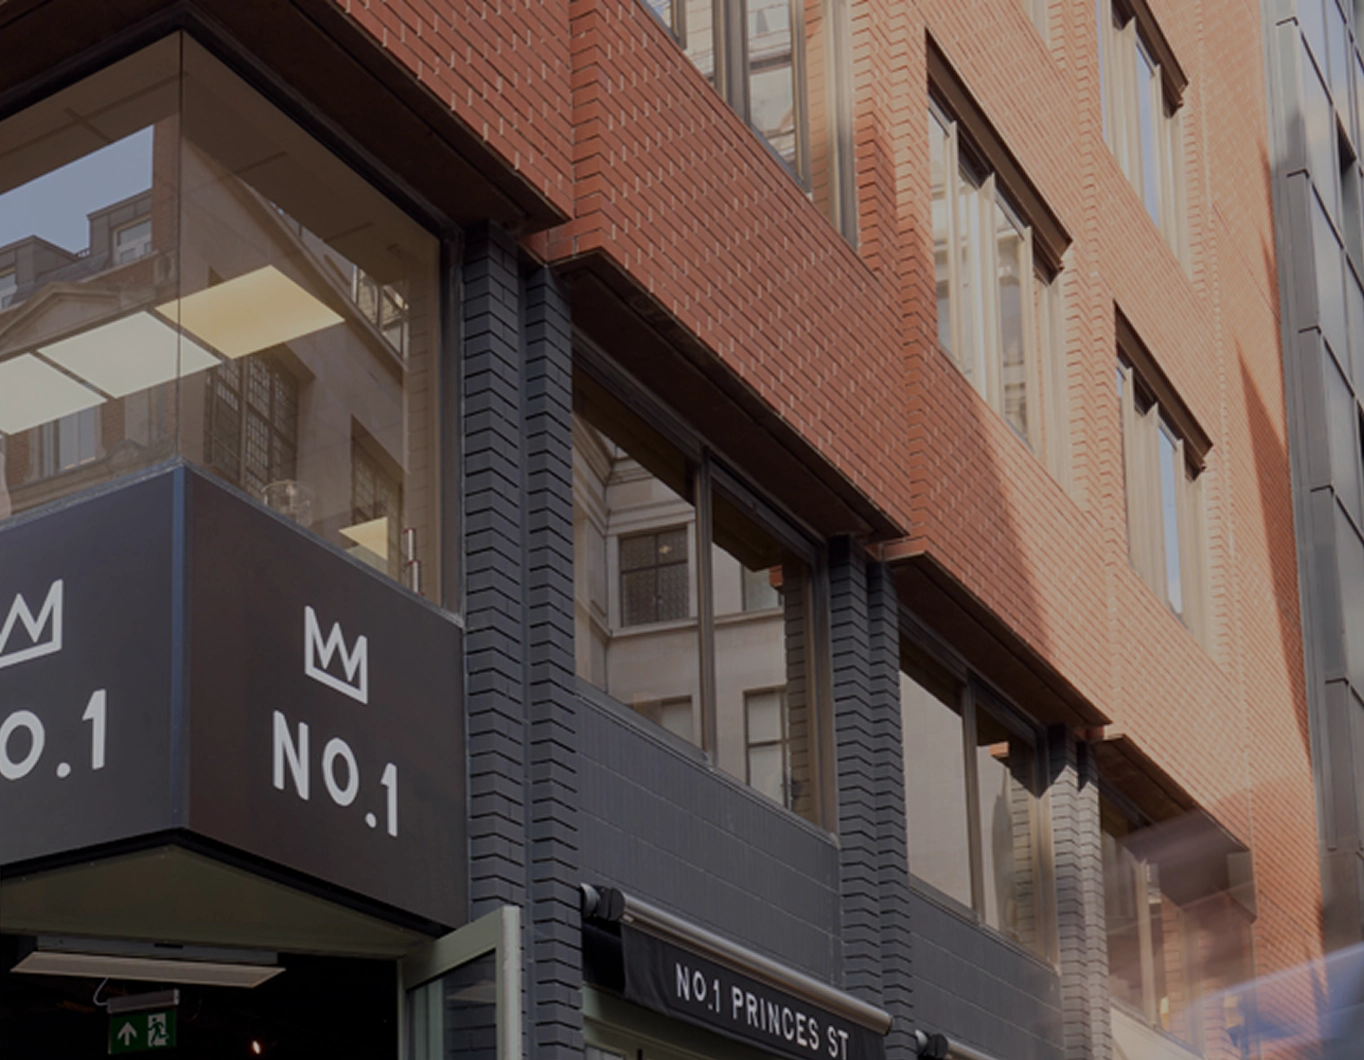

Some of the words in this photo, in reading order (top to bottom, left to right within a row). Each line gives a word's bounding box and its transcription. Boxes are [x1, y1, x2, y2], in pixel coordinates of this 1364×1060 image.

[272, 709, 399, 838] NO.1
[675, 962, 721, 1013] NO.1
[731, 986, 819, 1051] PRINCES
